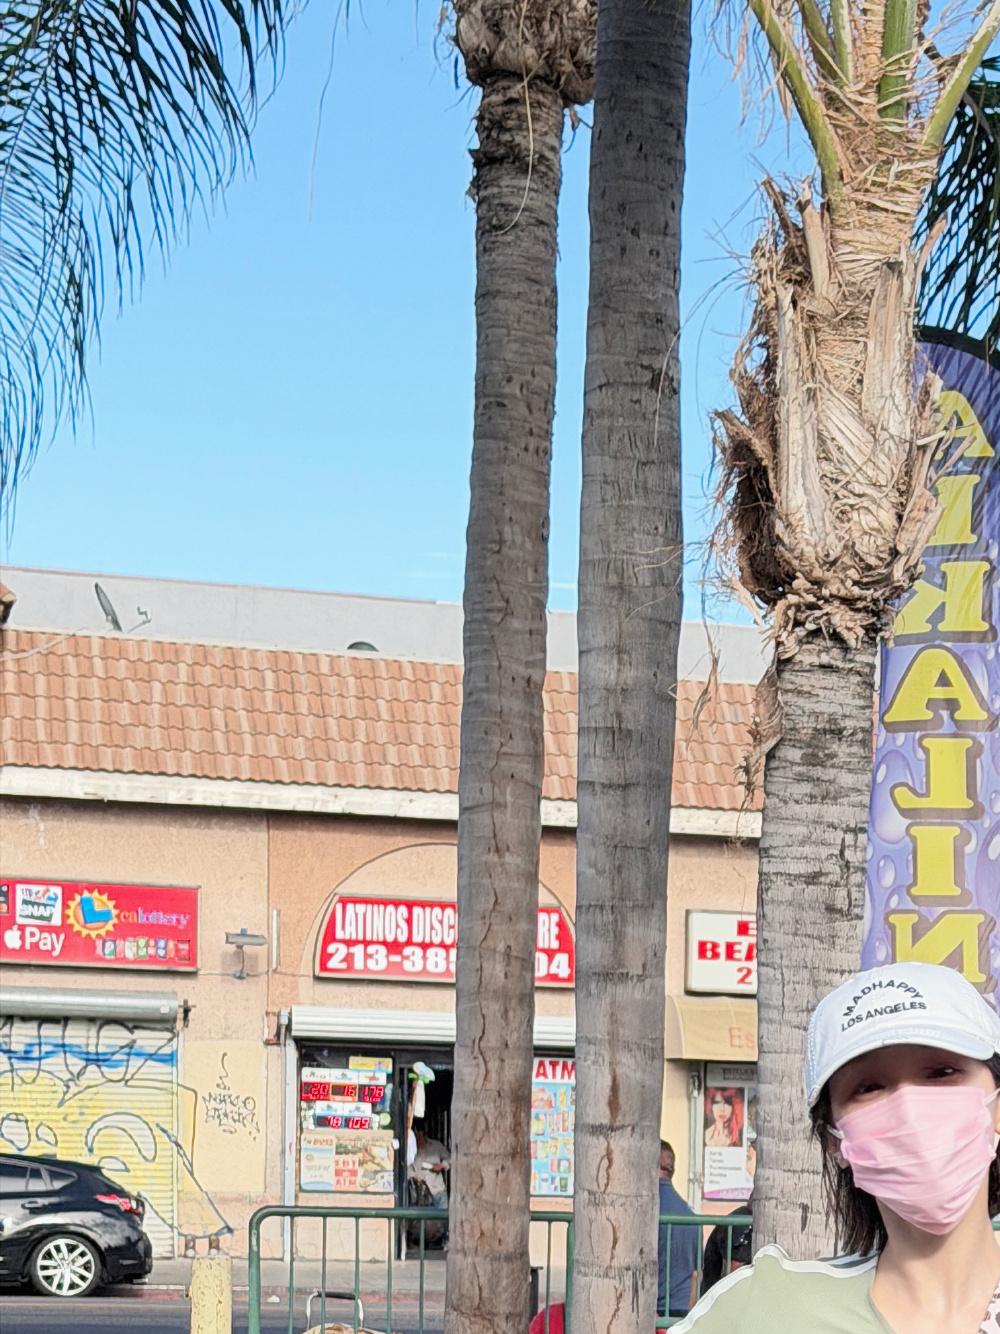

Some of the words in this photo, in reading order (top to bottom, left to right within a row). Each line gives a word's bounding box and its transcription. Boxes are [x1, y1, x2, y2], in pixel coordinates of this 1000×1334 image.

[335, 902, 408, 942] LATINOS
[412, 906, 458, 946] DISC
[25, 927, 65, 957] Pay
[842, 979, 924, 1017] MADHAPPY
[841, 1014, 864, 1032] LOS
[865, 1001, 928, 1021] ANGELES
[728, 1026, 756, 1049] Es
[535, 1059, 576, 1080] ATM
